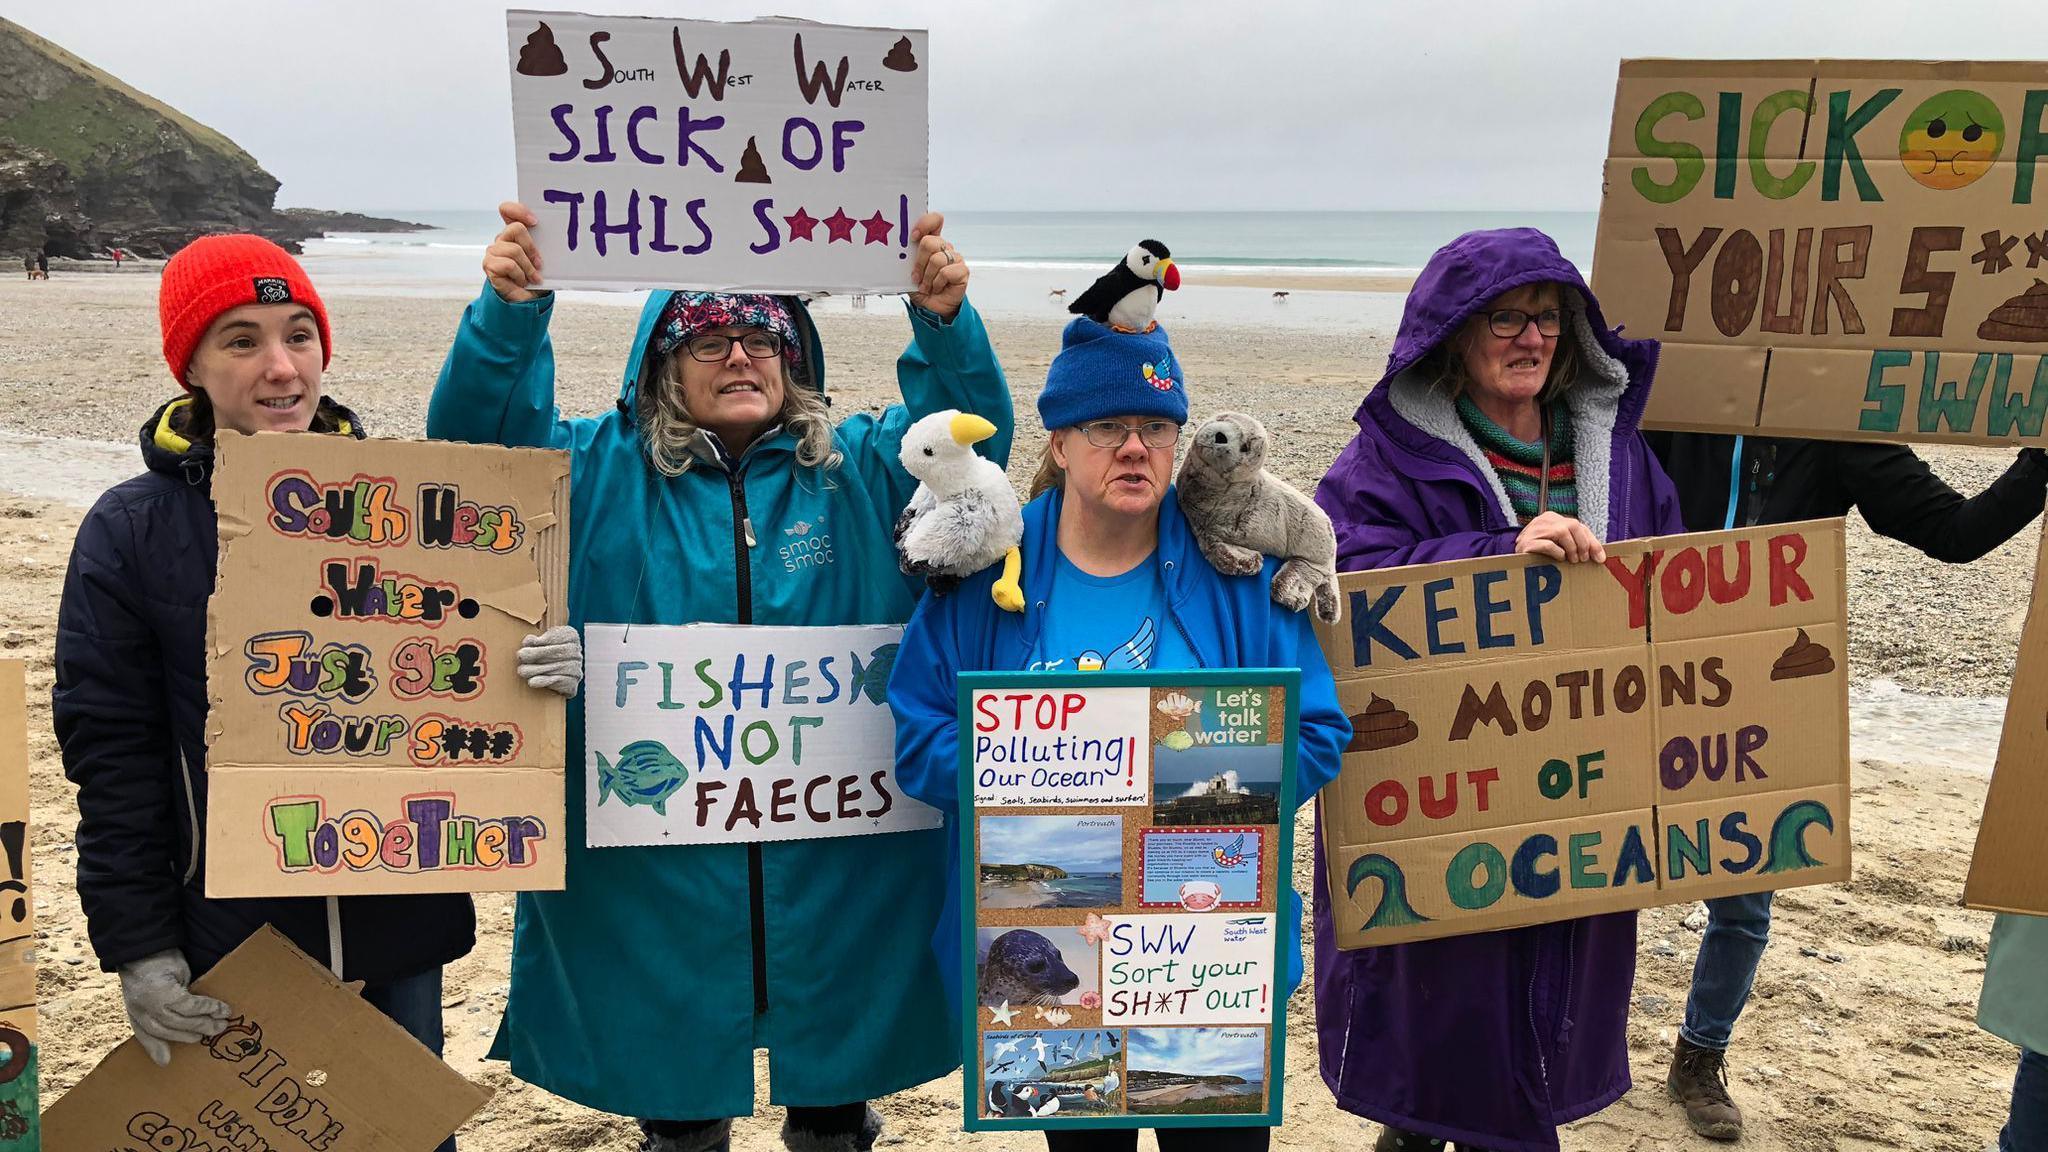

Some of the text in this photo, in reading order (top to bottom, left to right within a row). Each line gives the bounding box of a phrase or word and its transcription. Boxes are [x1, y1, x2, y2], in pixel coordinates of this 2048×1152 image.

[583, 26, 885, 107] SOUTH WEST WATER
[549, 104, 865, 173] SICK OF
[1631, 88, 1904, 203] SICK
[543, 188, 713, 257] THIS
[1655, 225, 1873, 338] YOUR
[1858, 349, 2048, 437] SWW
[271, 477, 526, 550] South West
[779, 534, 832, 560] smoc
[784, 549, 835, 573] smoc
[326, 563, 456, 621] Water
[1348, 532, 1815, 668] KEEP YOUR
[250, 635, 482, 697] Just get
[615, 653, 841, 712] FISHES
[976, 693, 1087, 733] STOP
[1216, 687, 1262, 707] Let's
[1218, 708, 1262, 727] talk
[1448, 656, 1733, 742] MOTIONS
[285, 707, 405, 751] Your
[694, 714, 824, 772] NOT
[1195, 727, 1262, 744] water
[694, 770, 893, 832] FAECES
[978, 768, 1104, 788] Our Ocean
[1364, 724, 1769, 827] OUT OF OUR
[1445, 811, 1762, 910] OCEANS
[1110, 923, 1197, 956] SWW
[1224, 927, 1268, 936] South West
[1109, 959, 1258, 988] Sort your
[1206, 983, 1267, 1014] OUT!
[239, 1048, 287, 1088] I
